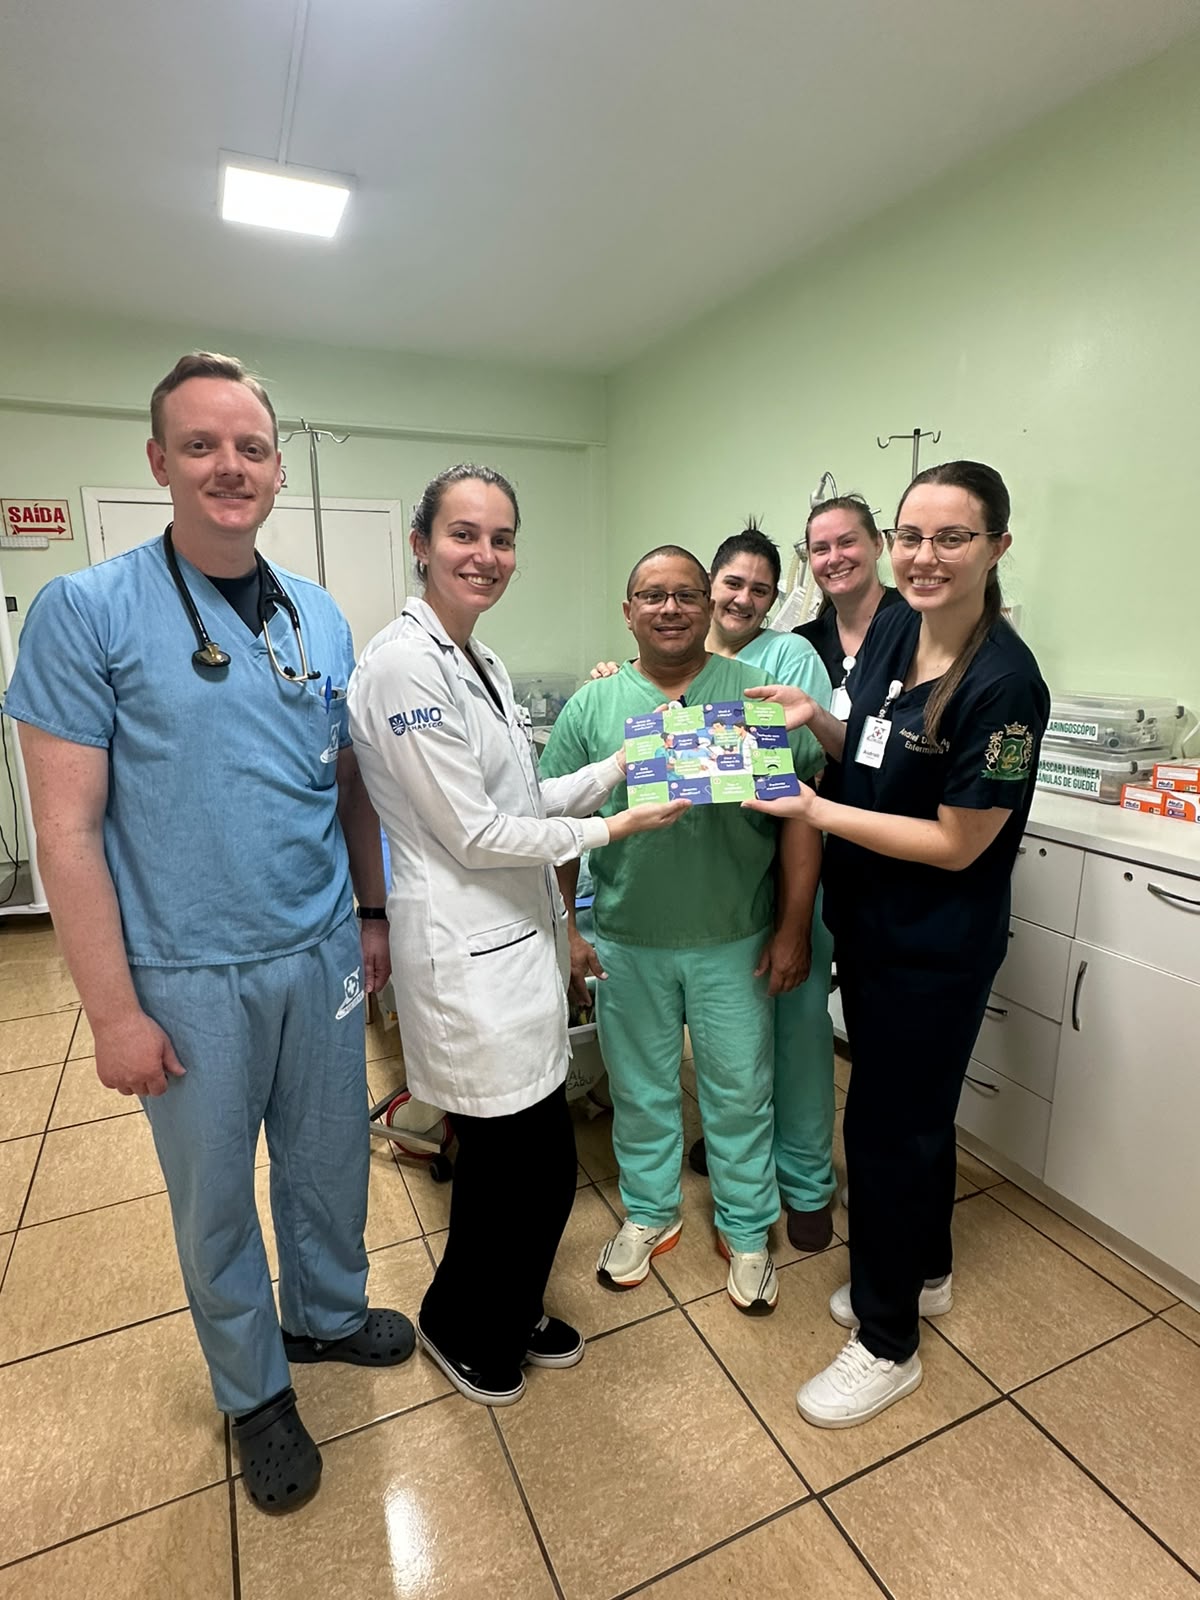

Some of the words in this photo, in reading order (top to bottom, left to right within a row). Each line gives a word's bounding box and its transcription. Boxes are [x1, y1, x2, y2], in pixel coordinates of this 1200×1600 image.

[8, 502, 66, 523] SAÍDA
[402, 707, 442, 726] UNO
[1063, 776, 1072, 788] DE
[1072, 778, 1098, 793] GUEDEL
